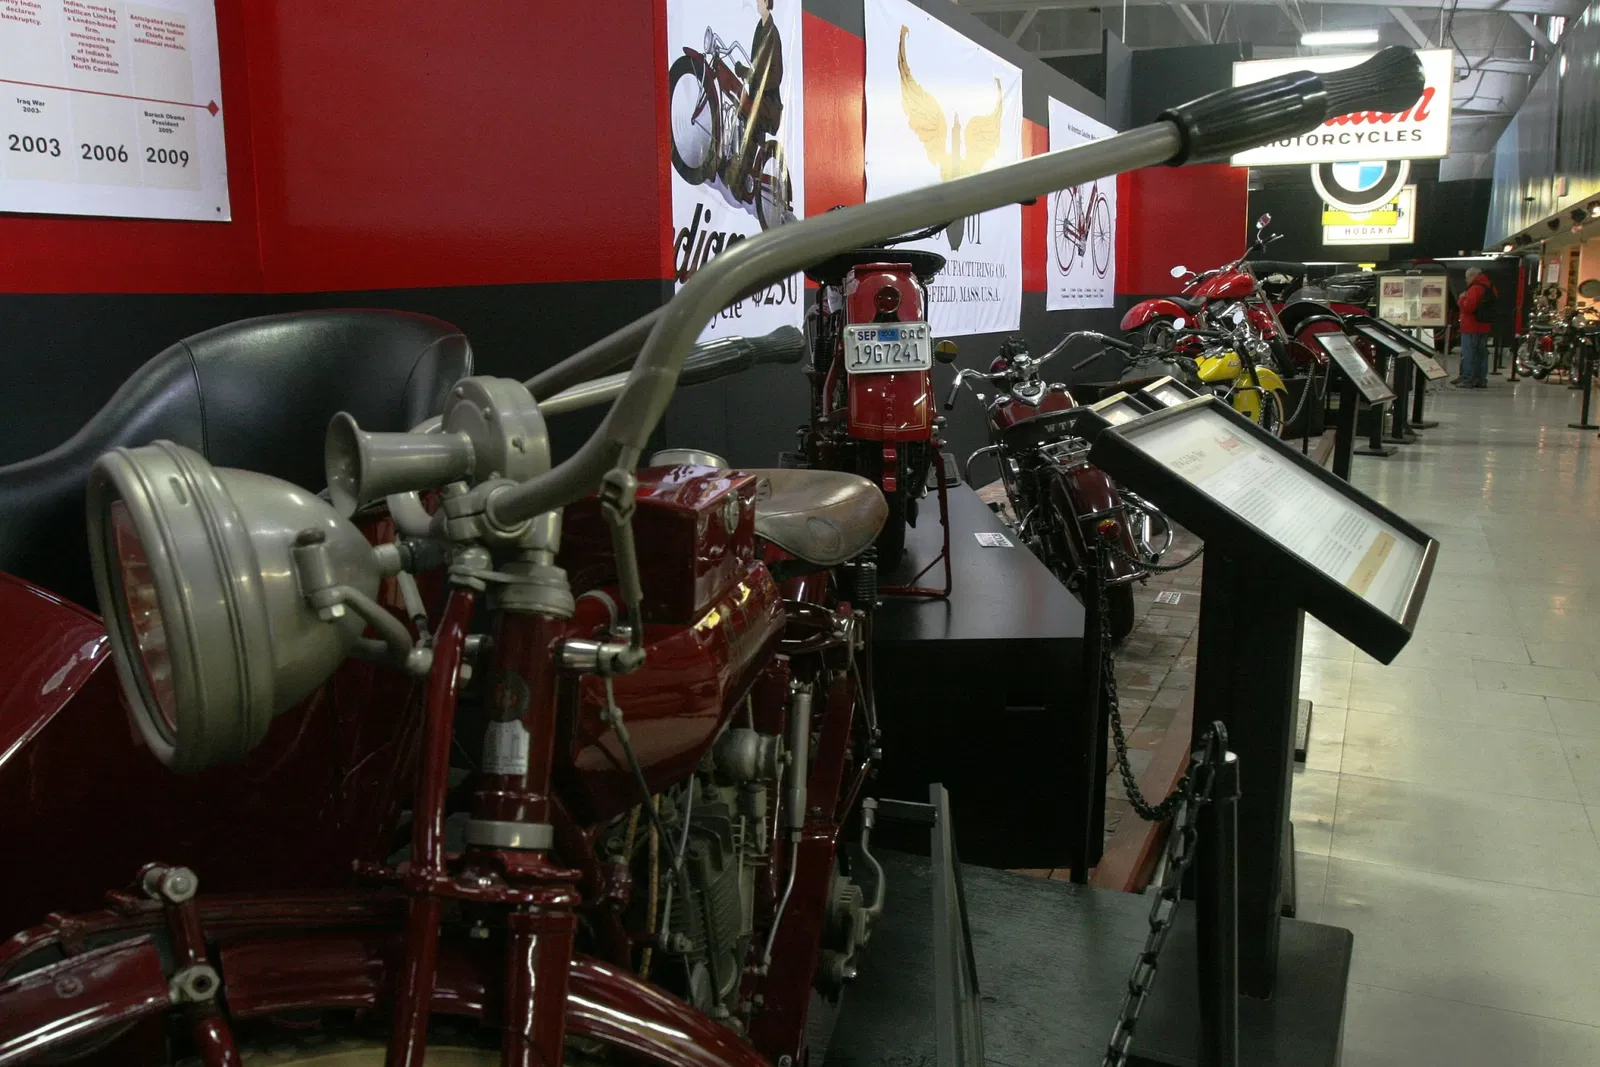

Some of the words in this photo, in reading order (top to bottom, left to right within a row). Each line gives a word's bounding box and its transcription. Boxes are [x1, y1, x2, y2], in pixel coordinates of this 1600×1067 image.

[20, 0, 41, 9] Indian
[87, 4, 107, 13] owned
[108, 7, 116, 15] by
[6, 6, 36, 16] declares
[1, 13, 42, 26] bankruptcy.
[130, 14, 163, 25] Anticipated
[164, 21, 186, 29] release
[70, 32, 105, 42] announces
[166, 28, 184, 36] Indian
[78, 41, 110, 51] reopening
[134, 38, 163, 47] additional
[85, 49, 105, 57] Indian
[71, 55, 89, 64] Kings
[90, 57, 119, 67] Mountain
[73, 62, 91, 71] North
[92, 65, 119, 75] Carolina
[16, 98, 31, 106] Iraq
[23, 106, 42, 114] 2003-
[144, 111, 165, 120] Barack
[166, 113, 186, 121] Obama
[152, 119, 179, 127] President
[8, 134, 61, 157] 2003
[81, 143, 128, 163] 2006
[146, 147, 189, 168] 2009
[1344, 227, 1393, 236] HODAKA
[857, 331, 877, 341] SEP
[854, 343, 921, 365] 19G7241
